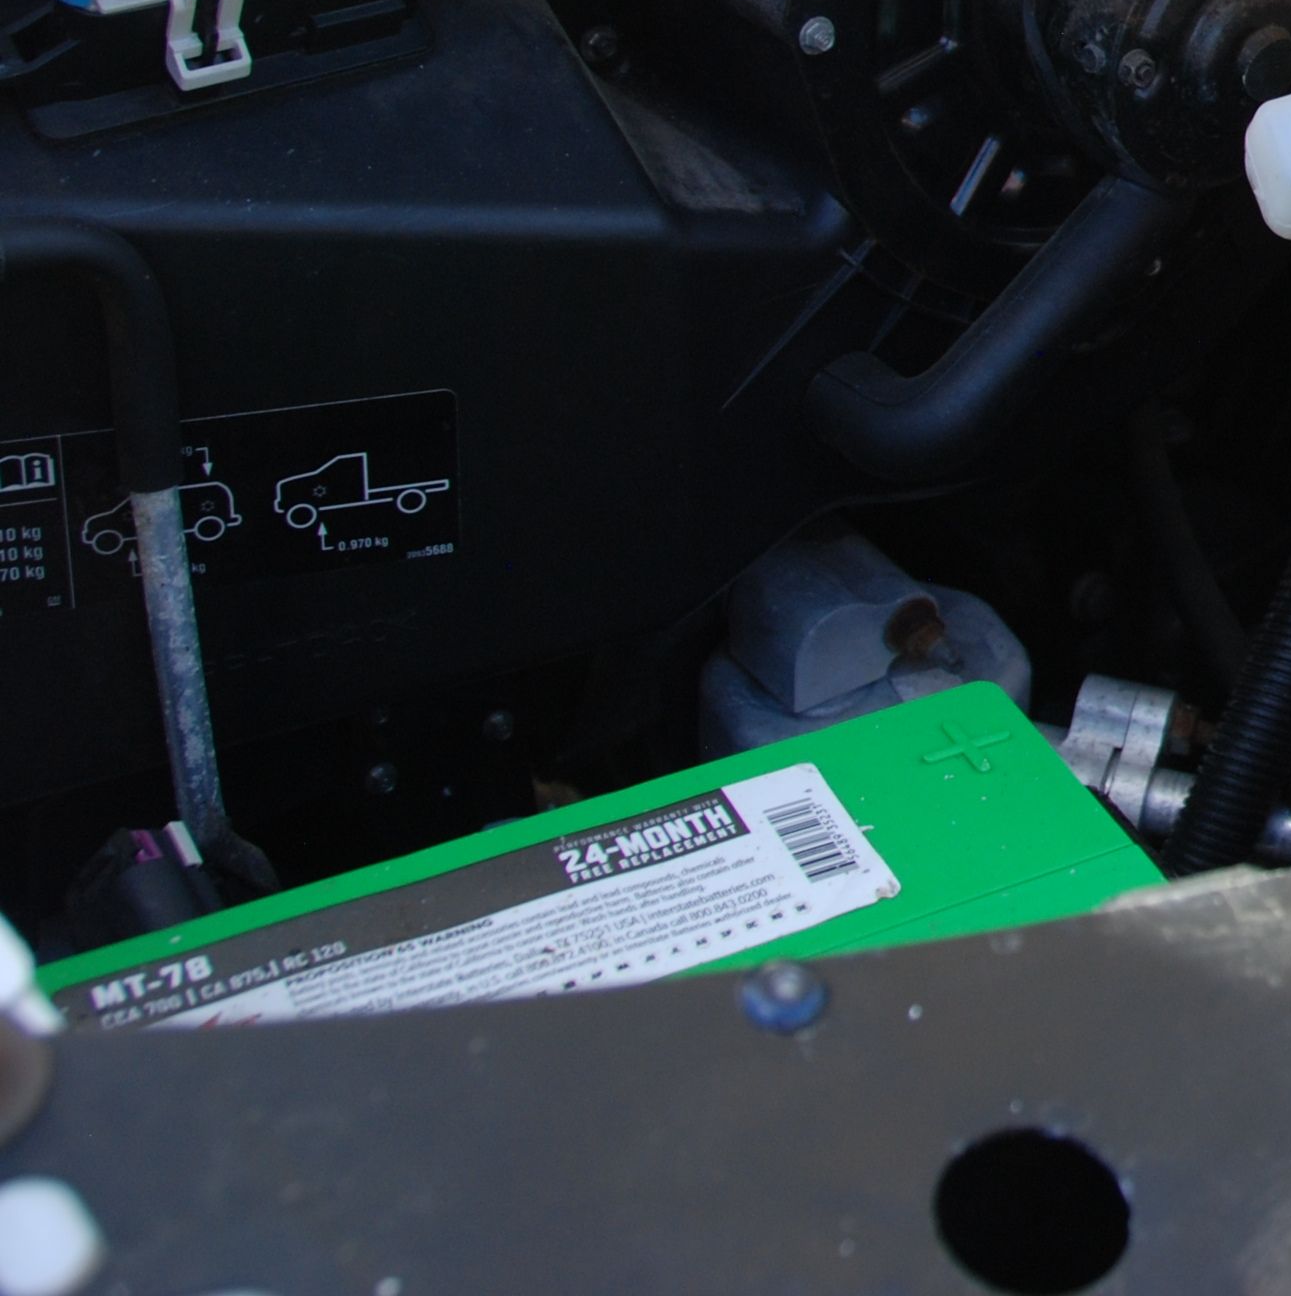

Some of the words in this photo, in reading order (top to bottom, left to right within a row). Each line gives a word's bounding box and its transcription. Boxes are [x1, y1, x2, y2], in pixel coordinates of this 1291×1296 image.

[21, 525, 42, 542] kg
[23, 544, 44, 561] kg
[338, 537, 373, 552] 0.970
[375, 536, 389, 548] kg
[25, 563, 46, 581] kg
[693, 797, 719, 811] WITH
[557, 804, 733, 873] 24-MONTH
[570, 862, 613, 883] FREE
[618, 823, 737, 869] REPLACEMENT
[613, 914, 640, 931] USA
[646, 871, 775, 921] interstatebatteries.com
[625, 919, 669, 941] Canada
[668, 910, 688, 925] call
[688, 886, 768, 919] 800.843.0200
[199, 980, 226, 999] CA
[281, 951, 309, 970] RC
[284, 947, 393, 986] PROPOSITION
[419, 918, 494, 946] WARNING
[90, 954, 213, 1010] MT-78
